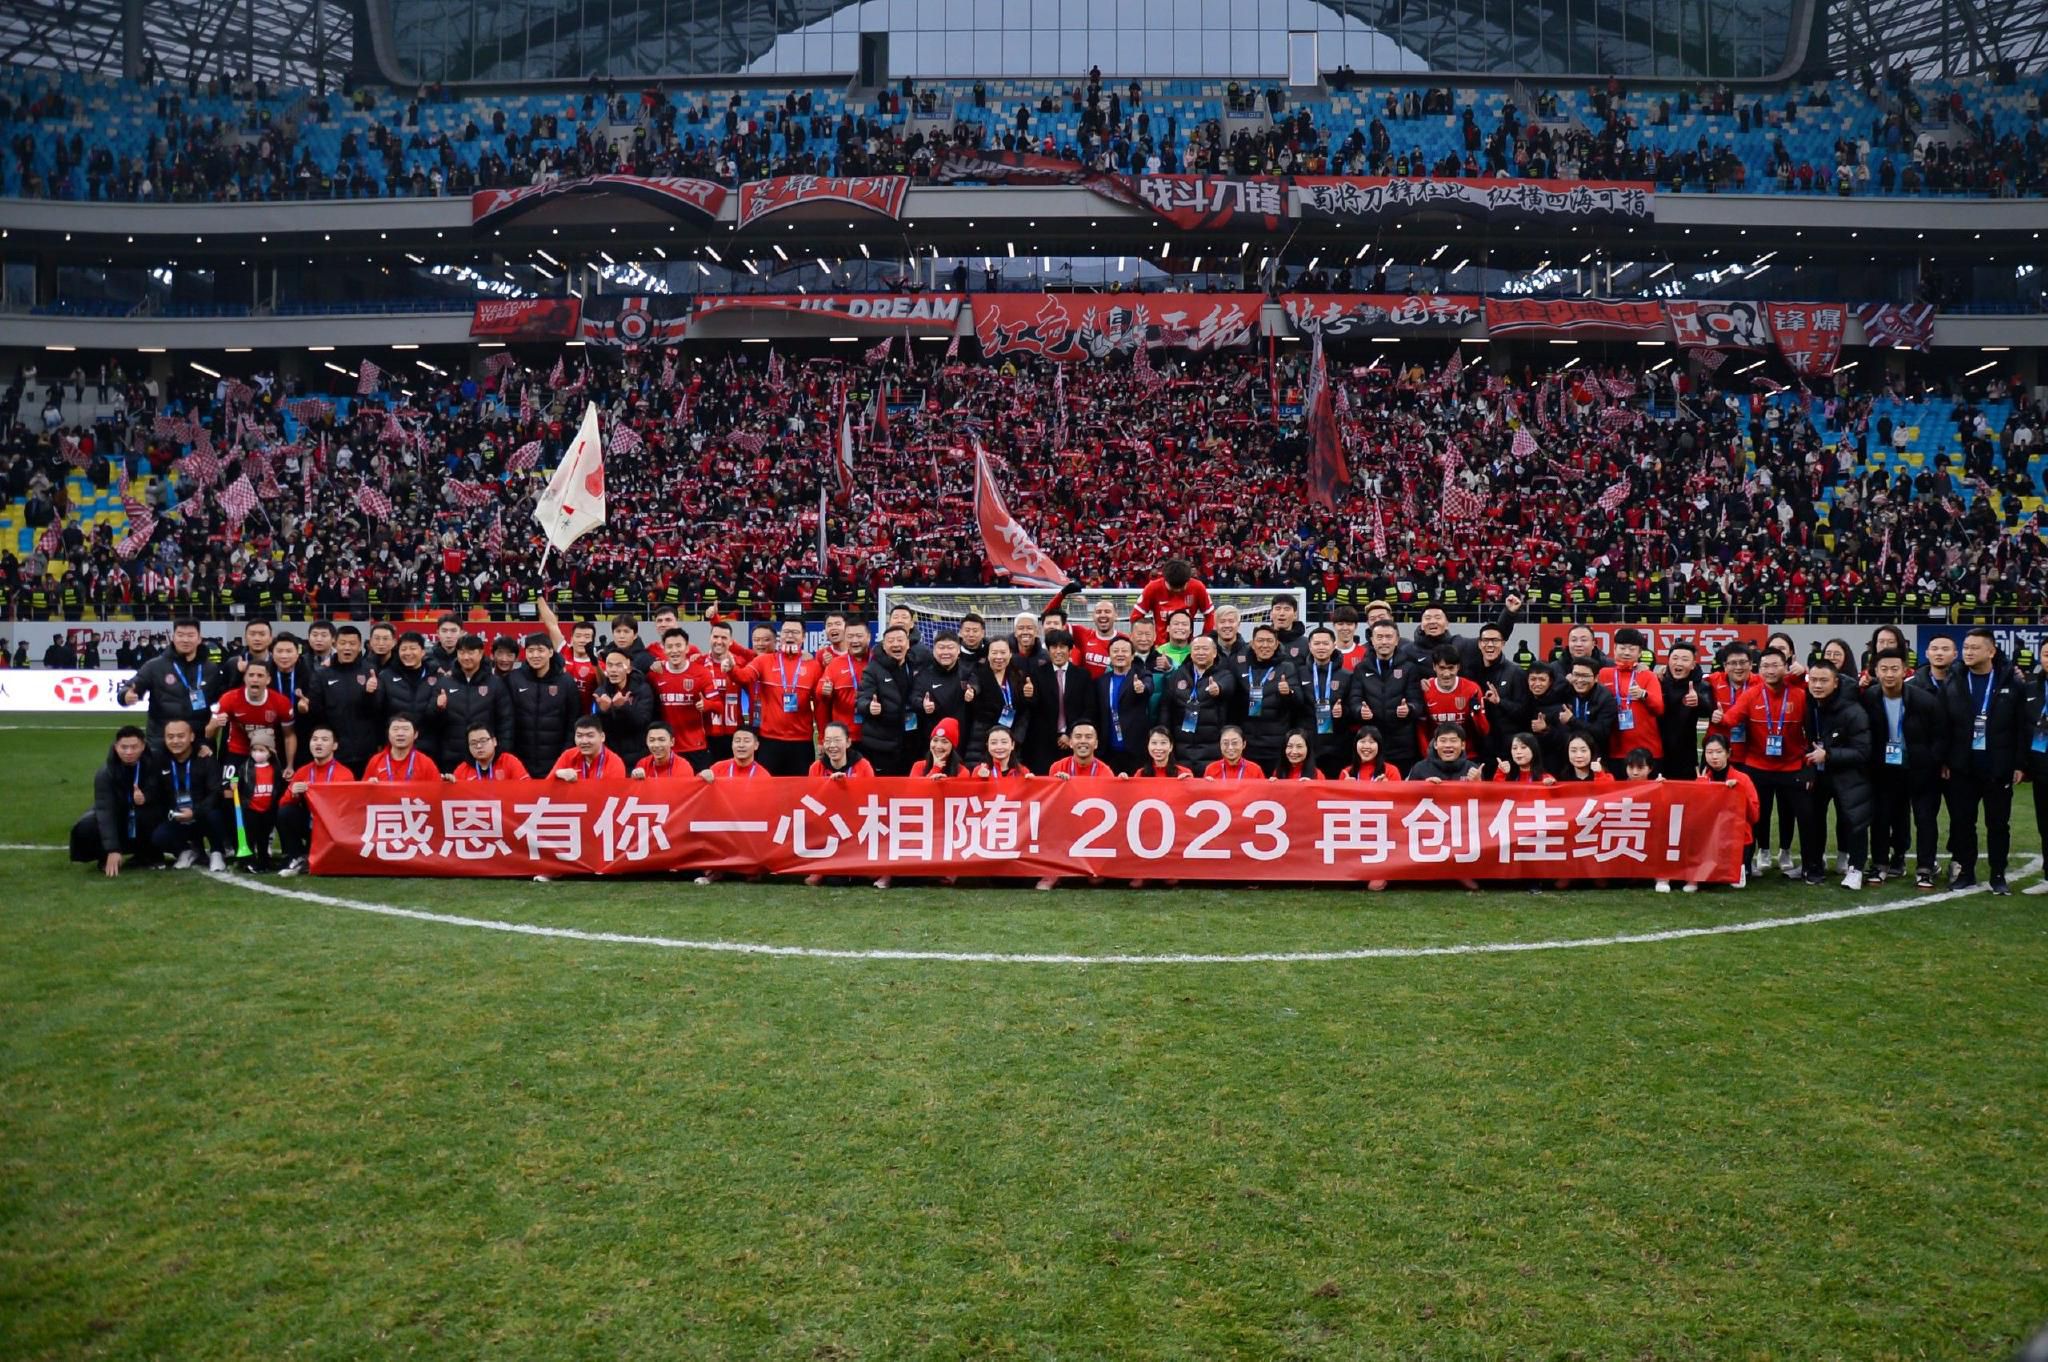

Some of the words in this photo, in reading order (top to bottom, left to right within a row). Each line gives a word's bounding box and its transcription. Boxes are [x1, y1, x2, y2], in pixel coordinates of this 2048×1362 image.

[1140, 178, 1282, 216] 战斗刀锋
[1310, 179, 1471, 214] 蜀将刀锋在此
[1487, 184, 1647, 217] 纵横四海可指
[480, 299, 538, 313] WELCOME
[848, 297, 960, 320] DREAM
[975, 294, 1090, 362] 红色
[1147, 303, 1253, 351] 正统
[359, 796, 671, 862] 感恩有你
[689, 794, 1041, 862] 一心相随!
[1068, 797, 1290, 862] 2023
[1314, 797, 1684, 864] 再创佳绩!
